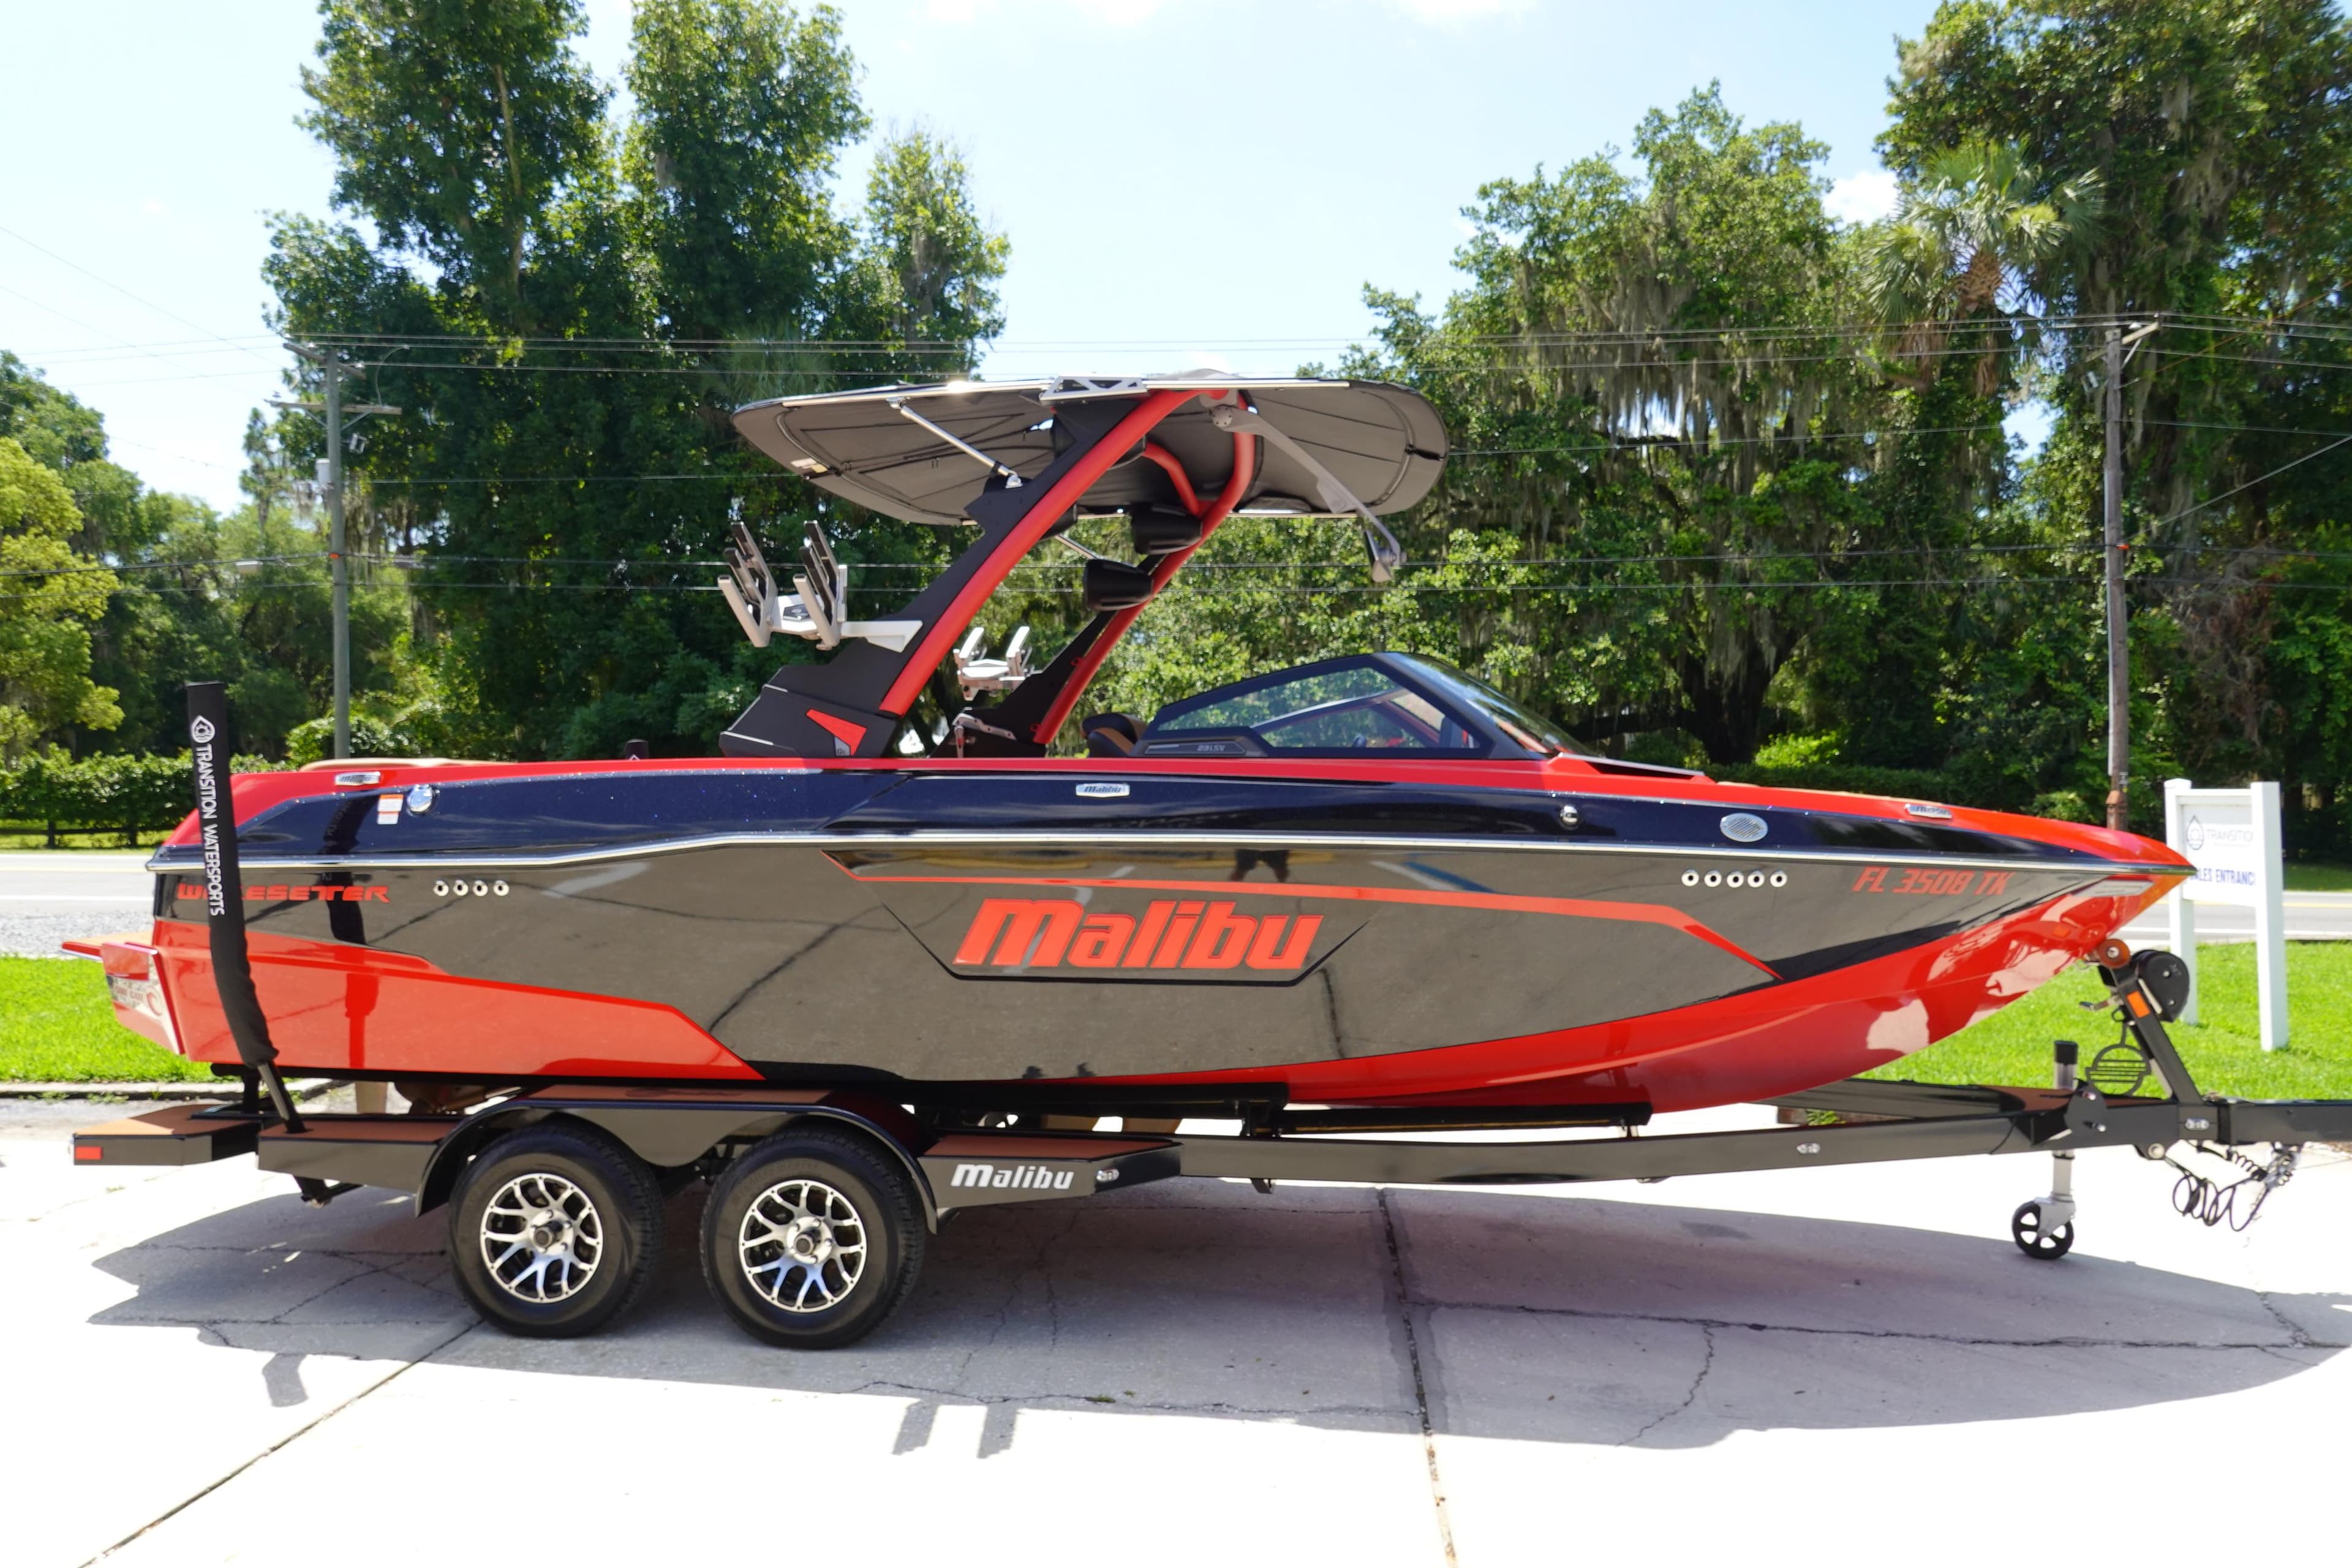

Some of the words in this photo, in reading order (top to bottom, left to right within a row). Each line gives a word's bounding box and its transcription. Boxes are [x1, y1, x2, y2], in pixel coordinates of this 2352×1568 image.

[195, 744, 218, 820] TRANSITION
[2205, 829, 2254, 842] TRANSITIO
[202, 823, 225, 916] WATERSPORTS
[1852, 865, 1890, 892] FL
[1891, 867, 1975, 895] 3508
[952, 899, 1324, 969] Malibu
[951, 1164, 1074, 1189] Malibu
